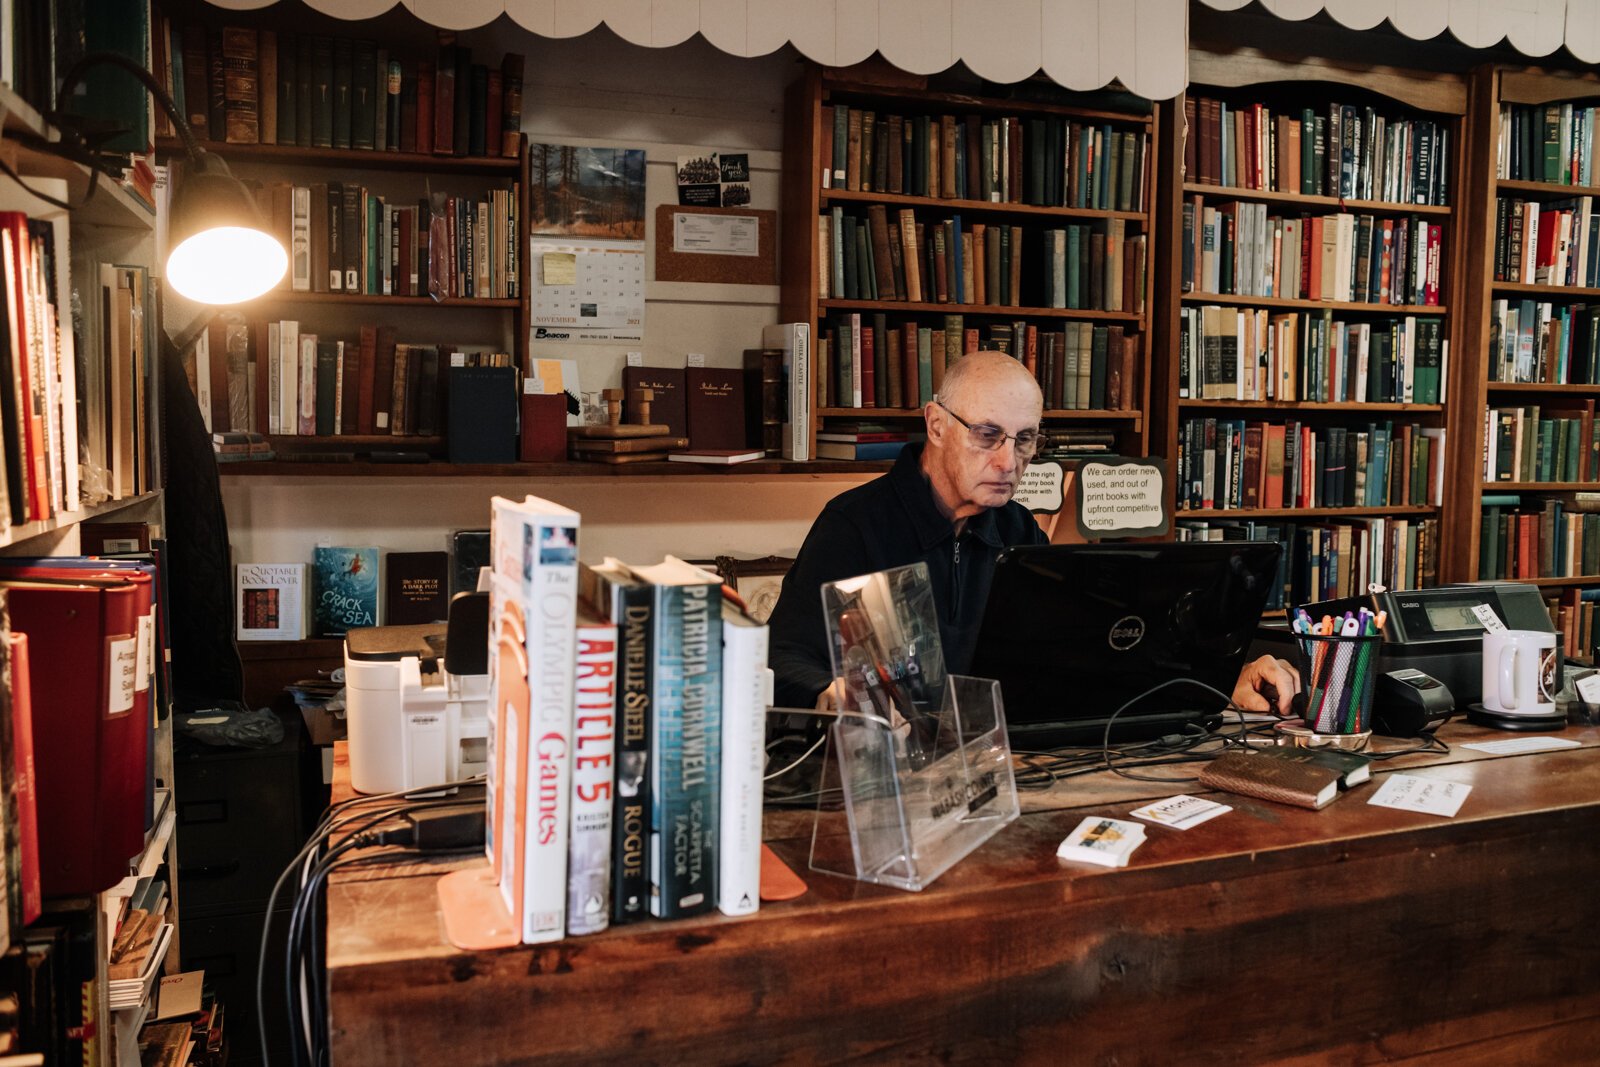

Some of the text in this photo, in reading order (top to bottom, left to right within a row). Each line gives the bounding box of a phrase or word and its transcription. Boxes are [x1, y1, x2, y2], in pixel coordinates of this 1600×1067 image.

[1419, 136, 1429, 181] WASHINGTON
[536, 316, 577, 324] NOVEMBER
[535, 328, 570, 339] Beacon
[1182, 331, 1190, 377] Autobiography
[1087, 467, 1100, 476] We
[1087, 479, 1148, 490] used, and out of
[1087, 492, 1146, 502] print books with
[1087, 504, 1159, 515] upfront competitive
[322, 590, 364, 612] CRACK
[342, 610, 373, 625] SEA
[1112, 628, 1140, 638] DELL
[622, 605, 650, 747] DANIELLE STEEL
[680, 586, 708, 791] PATRICIA CORNWELL
[536, 569, 573, 845] The OLYMPIC Games
[576, 639, 615, 803] ARTICLE 5
[622, 804, 643, 879] ROGUE
[673, 815, 689, 877] FACTOR
[688, 799, 704, 885] SCARPETTA
[703, 829, 713, 849] THE
